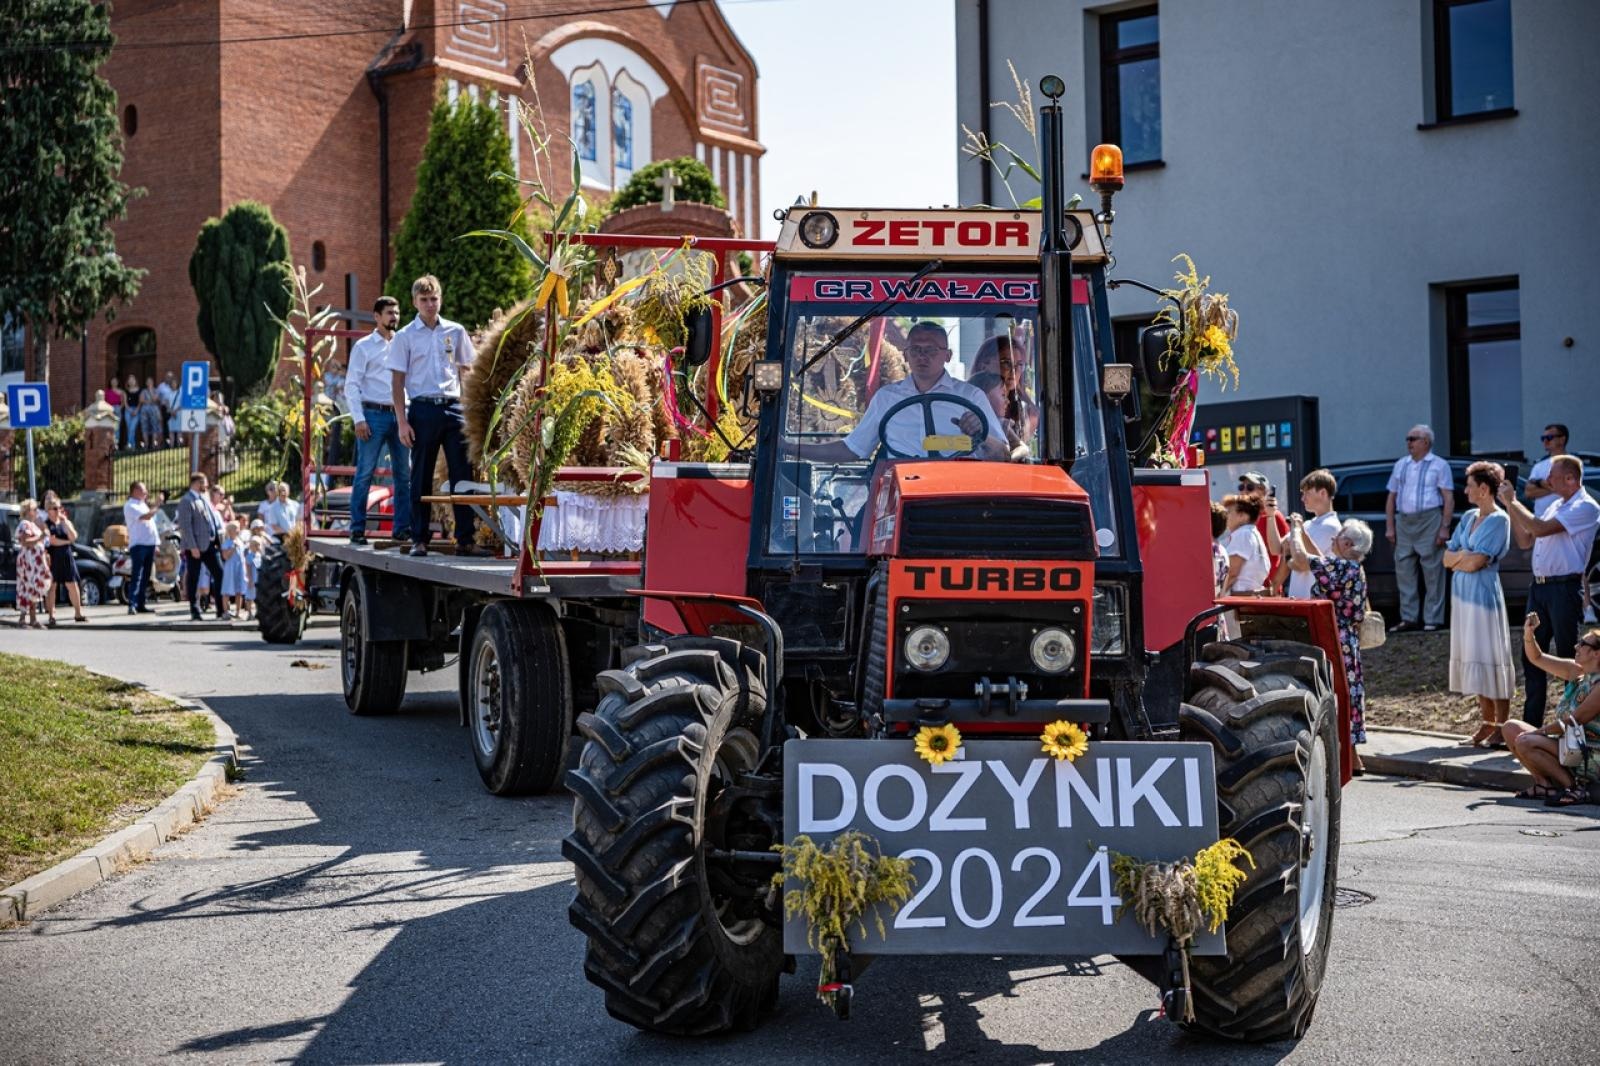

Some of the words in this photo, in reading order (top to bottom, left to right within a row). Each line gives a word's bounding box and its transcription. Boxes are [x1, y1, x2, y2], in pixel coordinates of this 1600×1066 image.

[852, 220, 1030, 247] ZETOR
[814, 279, 873, 301] GR
[188, 366, 203, 395] P
[18, 389, 41, 422] P
[904, 565, 1081, 592] TURBO
[894, 845, 1123, 929] 2024
